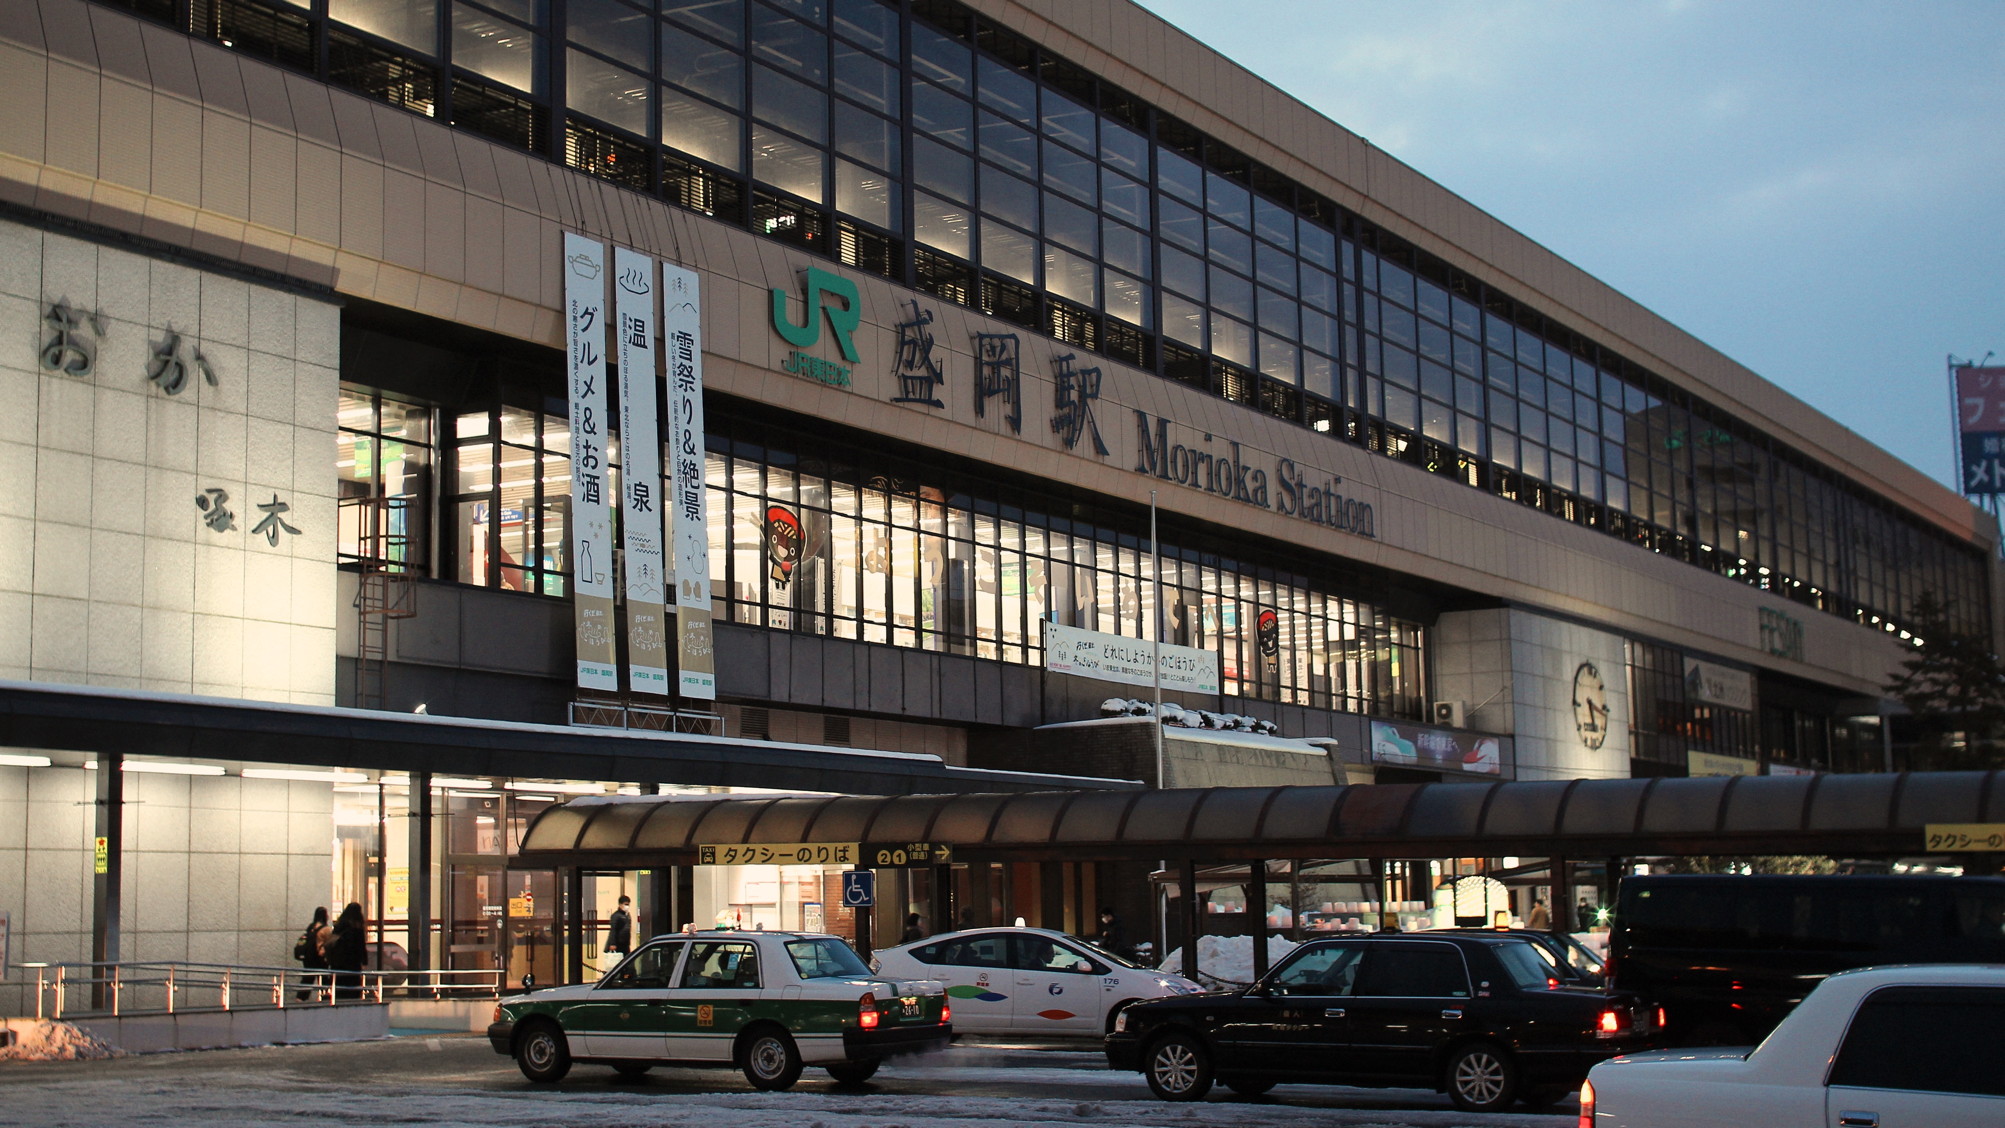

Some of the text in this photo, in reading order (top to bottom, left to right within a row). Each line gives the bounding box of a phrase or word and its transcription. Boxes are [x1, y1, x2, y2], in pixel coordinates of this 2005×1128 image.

[773, 266, 861, 364] JR
[782, 350, 852, 387] JR東日本
[890, 299, 1110, 456] 盛岡駅
[1133, 409, 1377, 539] Morioka Station
[714, 845, 850, 864] タクシーのりば
[1929, 833, 2005, 848] タクシーの
[1103, 977, 1119, 985] 176
